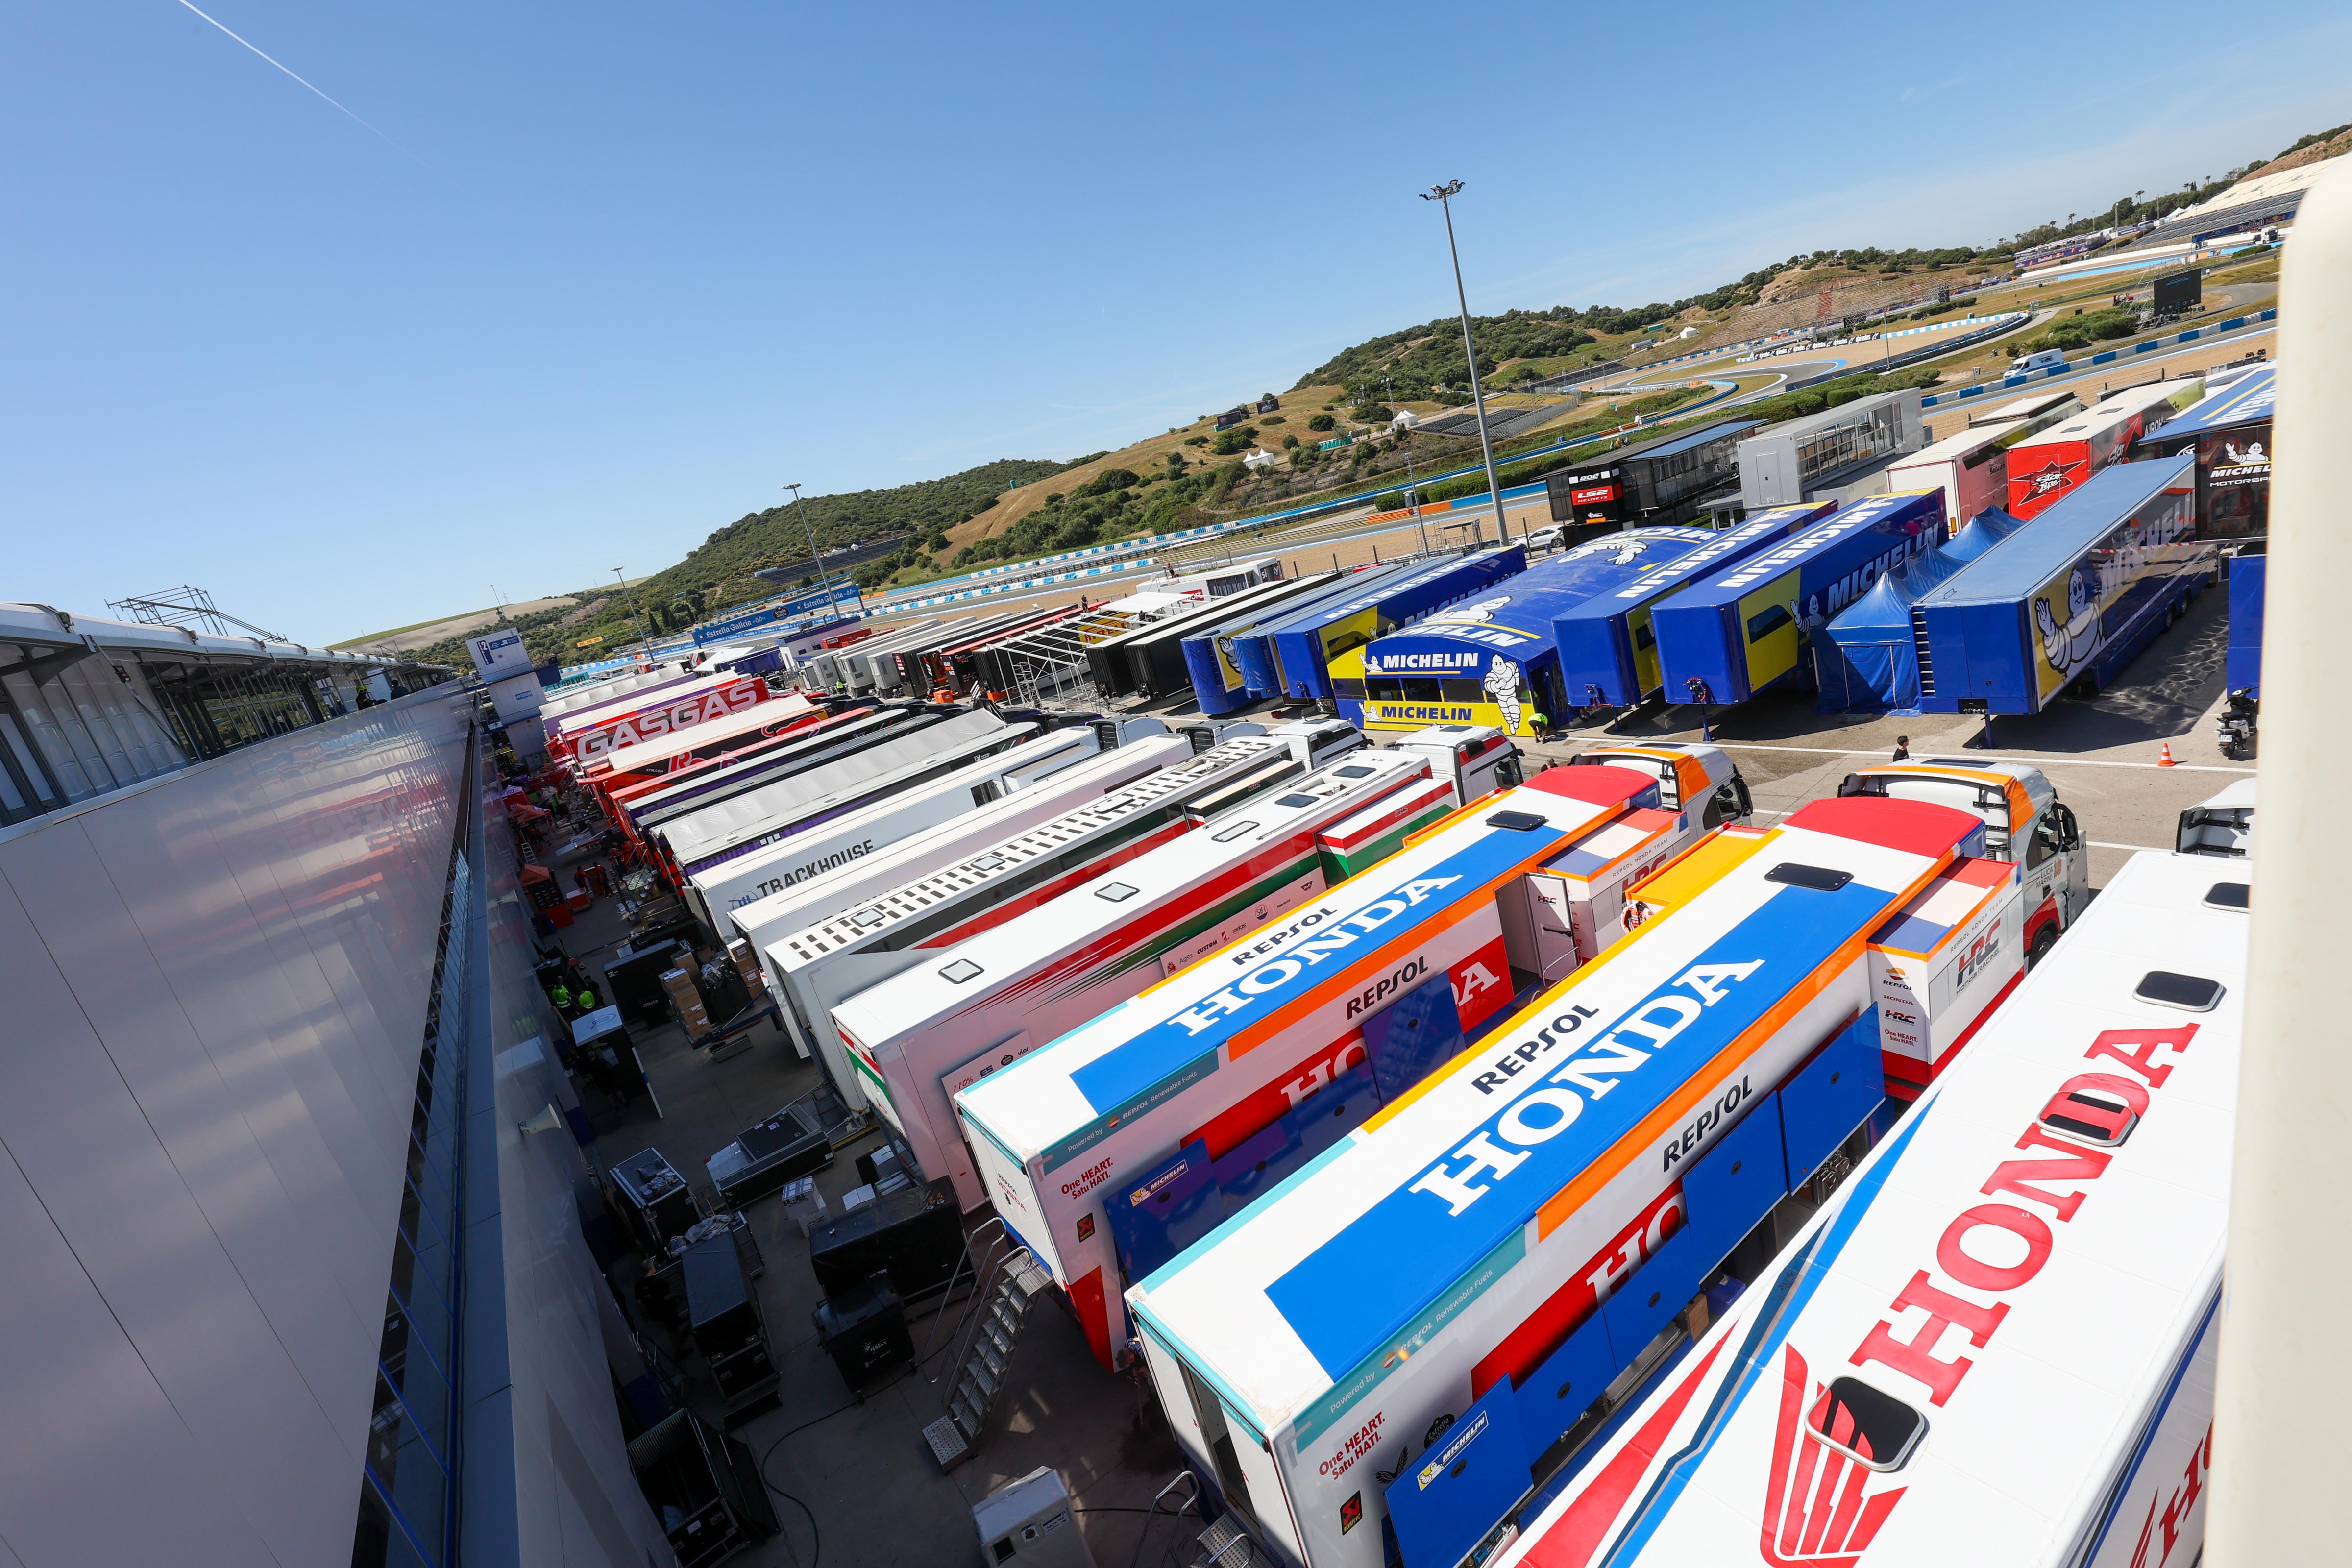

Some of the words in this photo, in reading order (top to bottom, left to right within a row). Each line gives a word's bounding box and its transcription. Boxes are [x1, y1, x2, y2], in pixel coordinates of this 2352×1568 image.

[2253, 219, 2264, 228] Bull
[2210, 465, 2272, 478] MICHEL
[1577, 489, 1608, 499] LS2
[1615, 522, 1776, 598] MICHELIN
[1716, 510, 1877, 587] MICHELIN
[2102, 491, 2195, 598] MICHELI
[803, 597, 824, 609] Estrella
[824, 592, 843, 603] Gaicia
[1324, 562, 1469, 619] MICHELIN
[481, 641, 488, 651] 2
[706, 626, 730, 638] Estrella
[730, 619, 752, 632] Galicia
[1383, 652, 1478, 668] MICHELIN
[552, 675, 585, 690] LEOPARD
[577, 682, 756, 761] GASGAS
[1381, 706, 1472, 721] MICHELIN
[706, 737, 779, 765] FACTORY
[783, 717, 840, 739] RACING
[757, 839, 874, 893] TRACKHOUSE
[1612, 862, 1632, 877] REPSOL
[1635, 849, 1652, 863] HONDA
[1654, 838, 1668, 850] TEAM
[2040, 866, 2053, 878] LUCA
[1232, 908, 1337, 965] REPSOL
[1950, 932, 1970, 953] REPSOL
[1971, 914, 1988, 932] HONDA
[1989, 898, 2003, 914] TEAM
[1167, 874, 1464, 1036] HONDA
[1197, 940, 1217, 954] CUSTOM
[1957, 917, 2001, 988] HRC
[1977, 948, 1999, 974] RACING
[1347, 956, 1428, 1020] REPSOL
[1883, 980, 1913, 991] REPSOL
[1883, 994, 1914, 1005] HONDA
[1885, 1009, 1916, 1024] HRC
[1885, 1029, 1897, 1037] One
[1897, 1031, 1918, 1042] HEART.
[1018, 1048, 1029, 1056] viar
[1471, 1004, 1600, 1095] REPSOL
[1901, 1037, 1915, 1046] HATI.
[954, 1076, 973, 1092] 110%
[1408, 959, 1767, 1218] HONDA
[1067, 1132, 1094, 1152] Powered
[1094, 1127, 1103, 1140] by
[1122, 1101, 1149, 1120] REPSOL
[1151, 1080, 1181, 1102] Renewable
[1181, 1071, 1198, 1085] Fuels
[1664, 1075, 1753, 1172] REPSOL
[1061, 1179, 1080, 1194] One
[1081, 1157, 1113, 1182] HEART.
[1072, 1185, 1089, 1200] Satu
[1089, 1171, 1111, 1189] HATI.
[1150, 1164, 1185, 1190] MICHELIN
[1849, 1023, 2200, 1408] HONDA
[1330, 1379, 1366, 1413] Powered
[1366, 1371, 1376, 1385] by
[1400, 1321, 1433, 1352] REPSOL
[1435, 1286, 1474, 1323] Renewable
[1474, 1269, 1493, 1289] Fuels
[1319, 1450, 1344, 1476] One
[1344, 1411, 1386, 1454] HEART.
[1332, 1459, 1355, 1480] Satu
[1354, 1431, 1382, 1462] HATI.
[1442, 1416, 1486, 1464] MICHELIN
